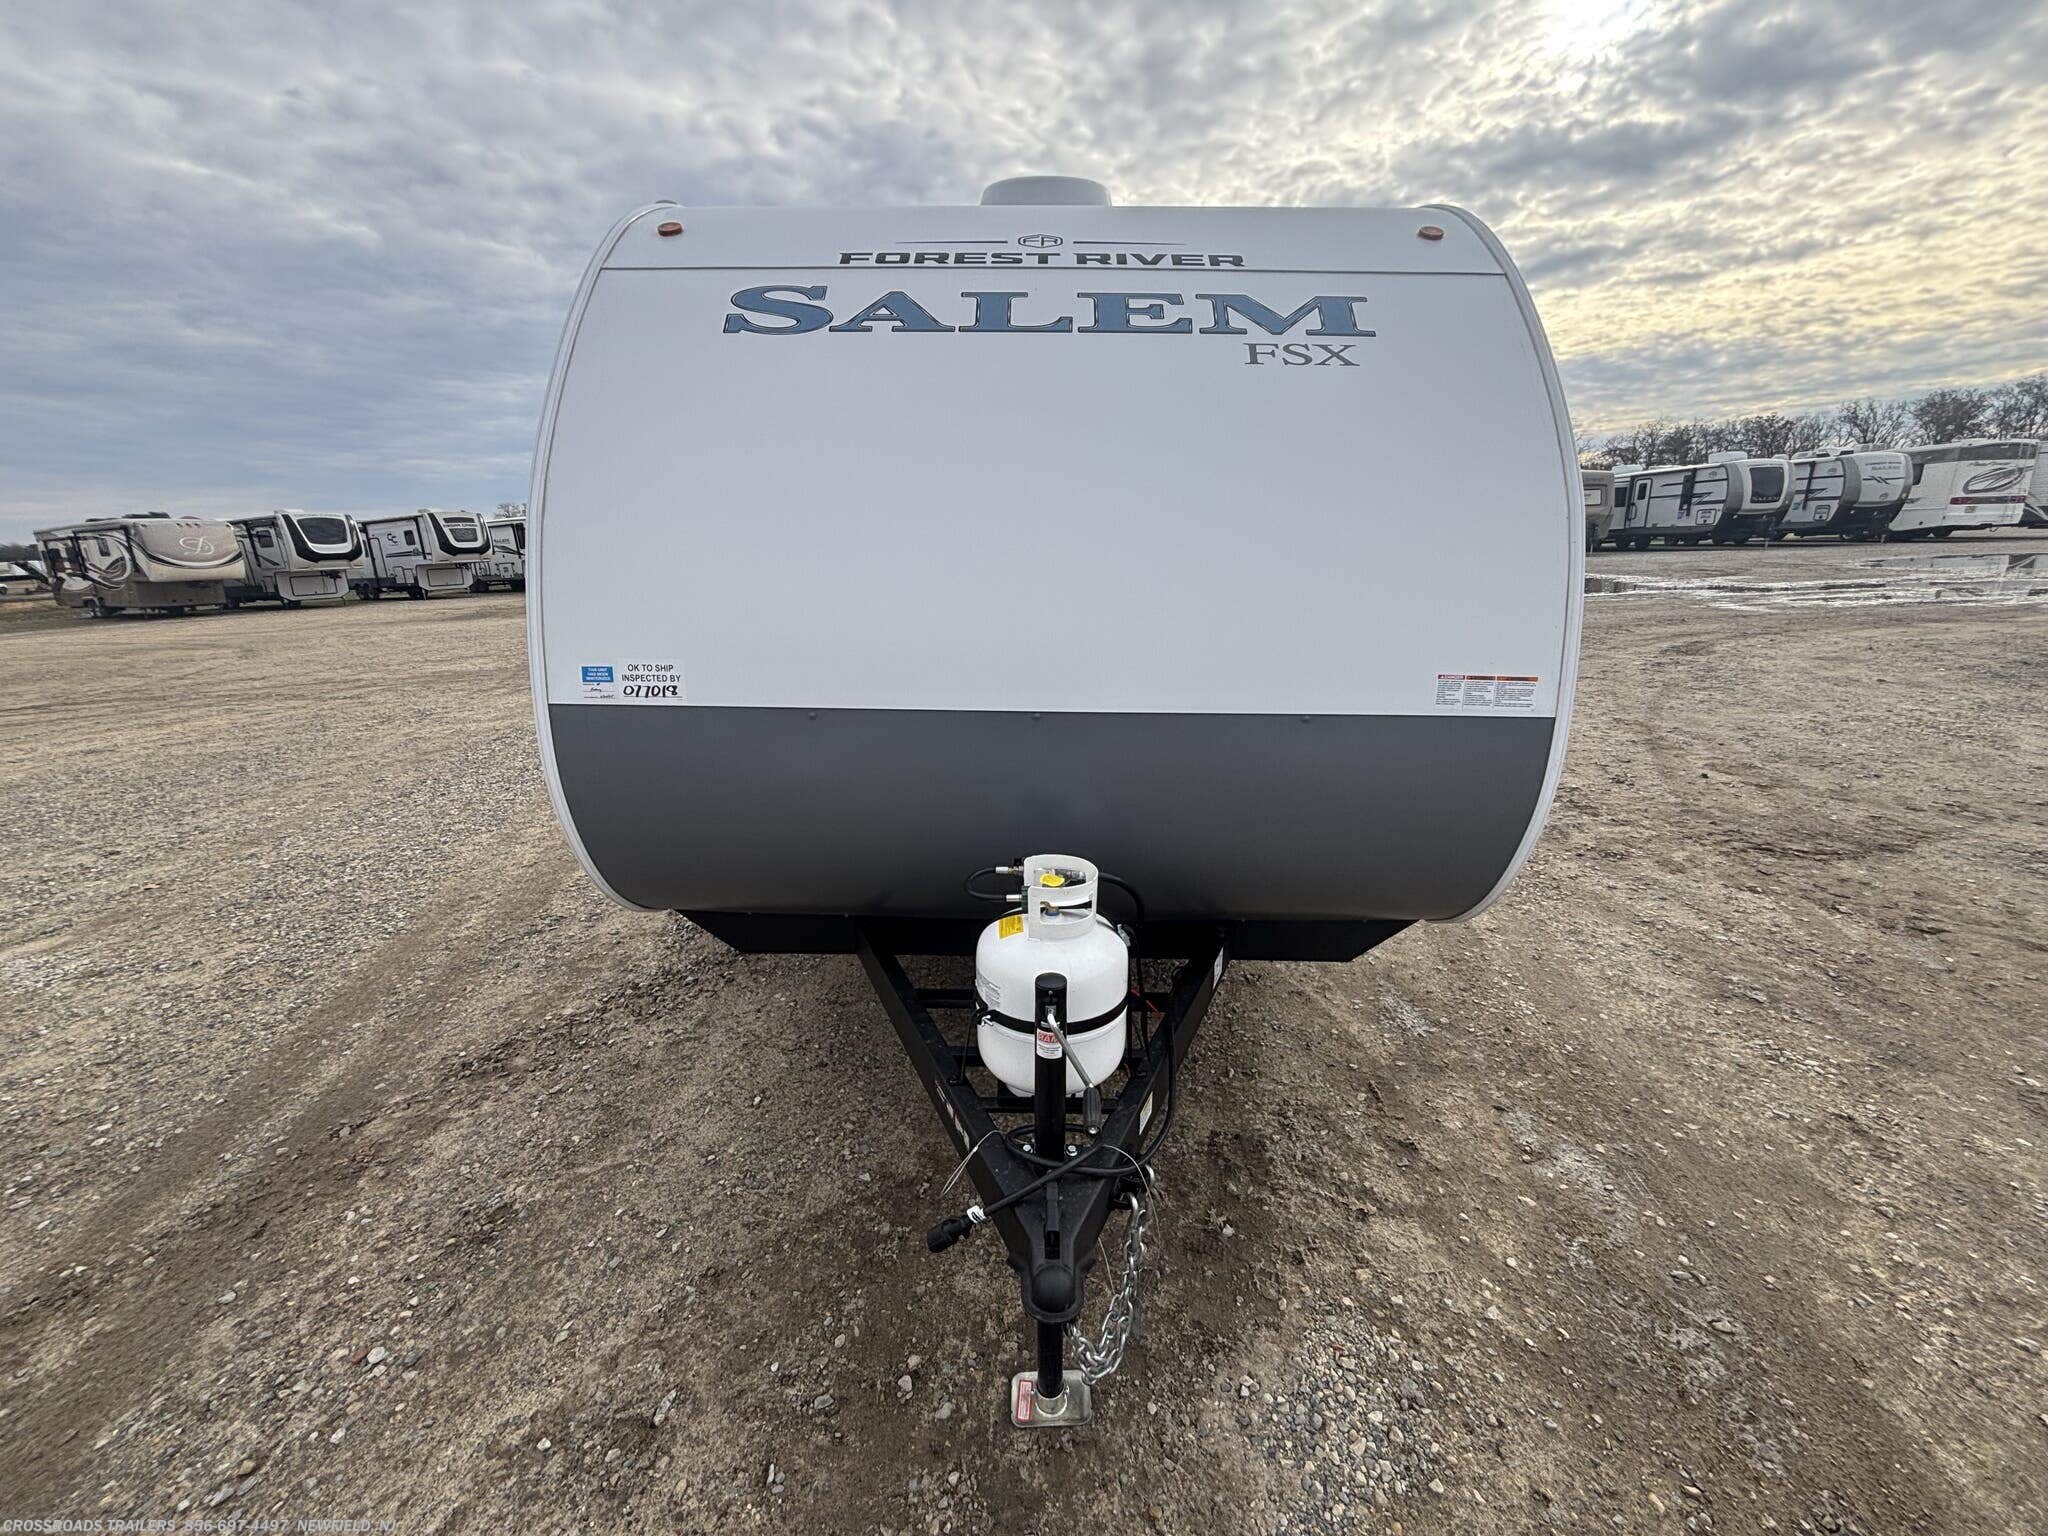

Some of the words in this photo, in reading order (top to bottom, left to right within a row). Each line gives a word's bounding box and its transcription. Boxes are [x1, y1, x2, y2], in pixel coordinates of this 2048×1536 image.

[839, 252, 1061, 265] FOREST
[1073, 253, 1246, 267] RIVER
[722, 284, 1377, 337] SALEM
[1243, 342, 1360, 367] FSX
[627, 663, 640, 672] OK
[642, 664, 653, 672] TO
[654, 664, 674, 672] SHIP
[621, 674, 668, 682] INSPECTED
[669, 674, 681, 683] BY
